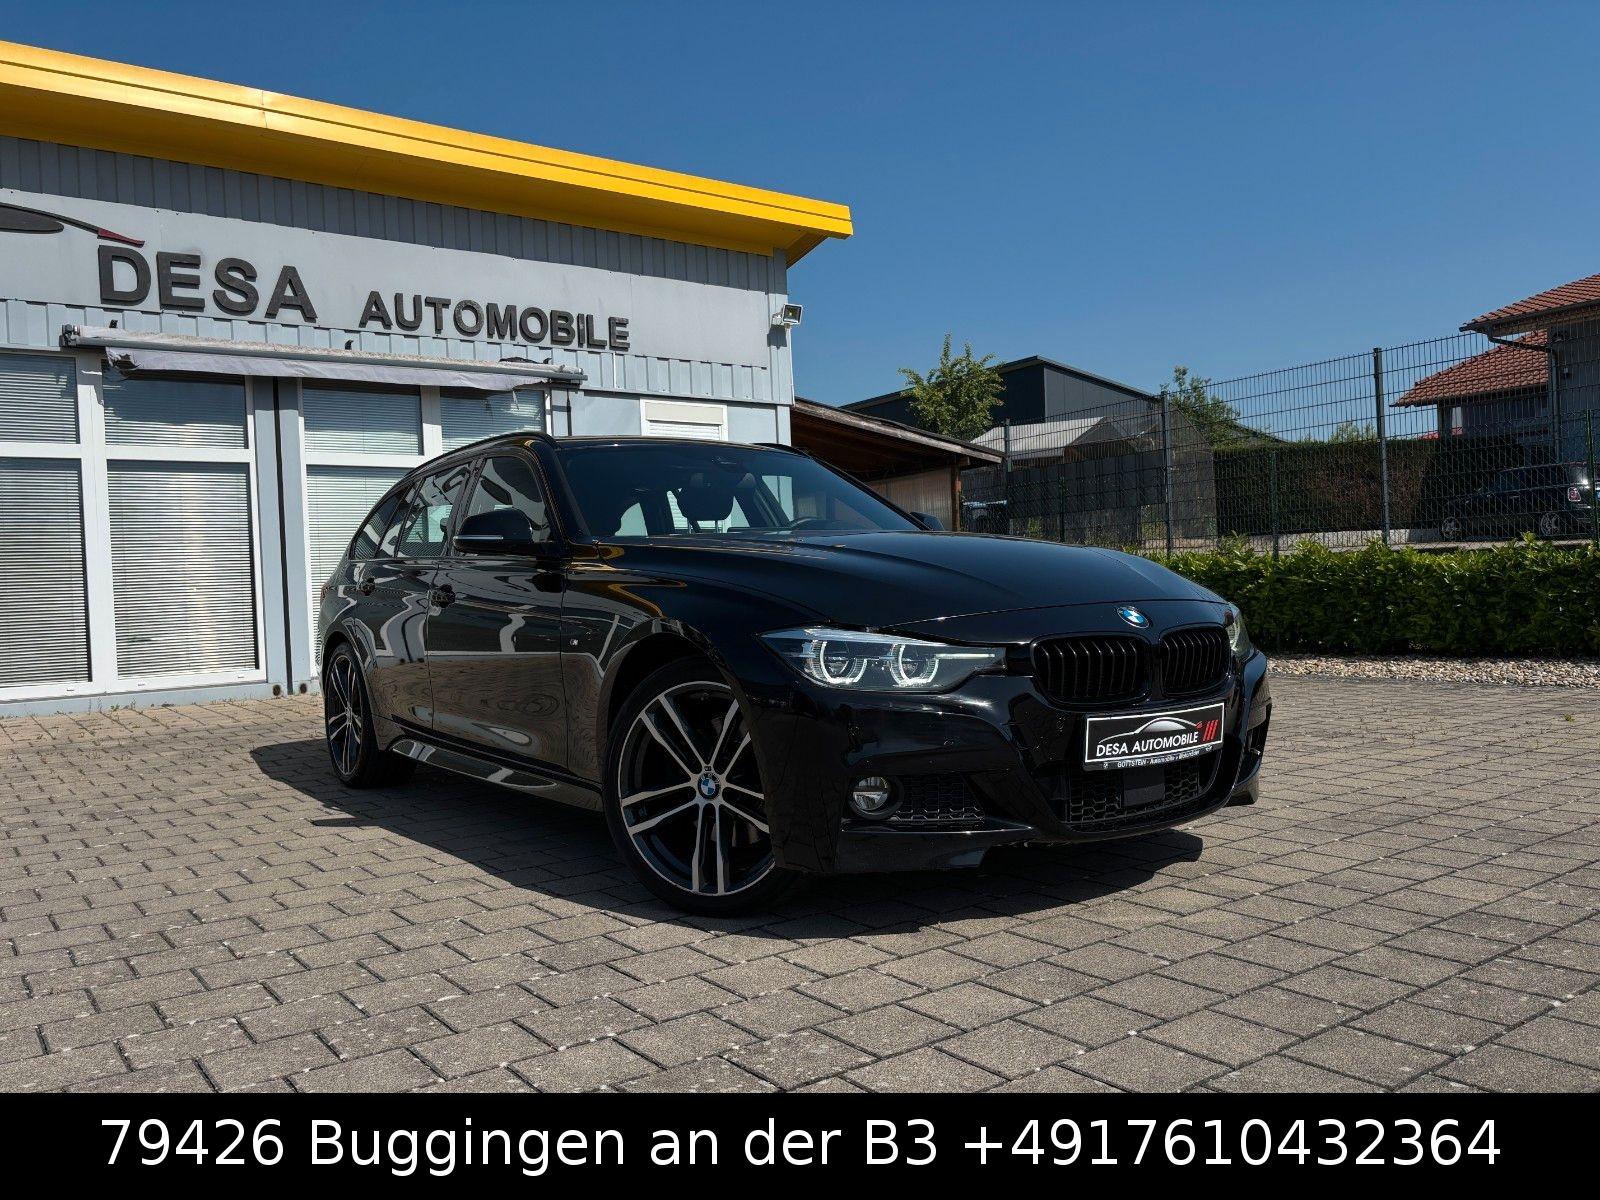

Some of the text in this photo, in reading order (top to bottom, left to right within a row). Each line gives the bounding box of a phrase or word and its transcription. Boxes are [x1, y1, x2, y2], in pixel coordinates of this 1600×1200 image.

[98, 245, 630, 349] DESA AUTOMOBILE
[1096, 732, 1199, 757] DESA AUTOMOBILE
